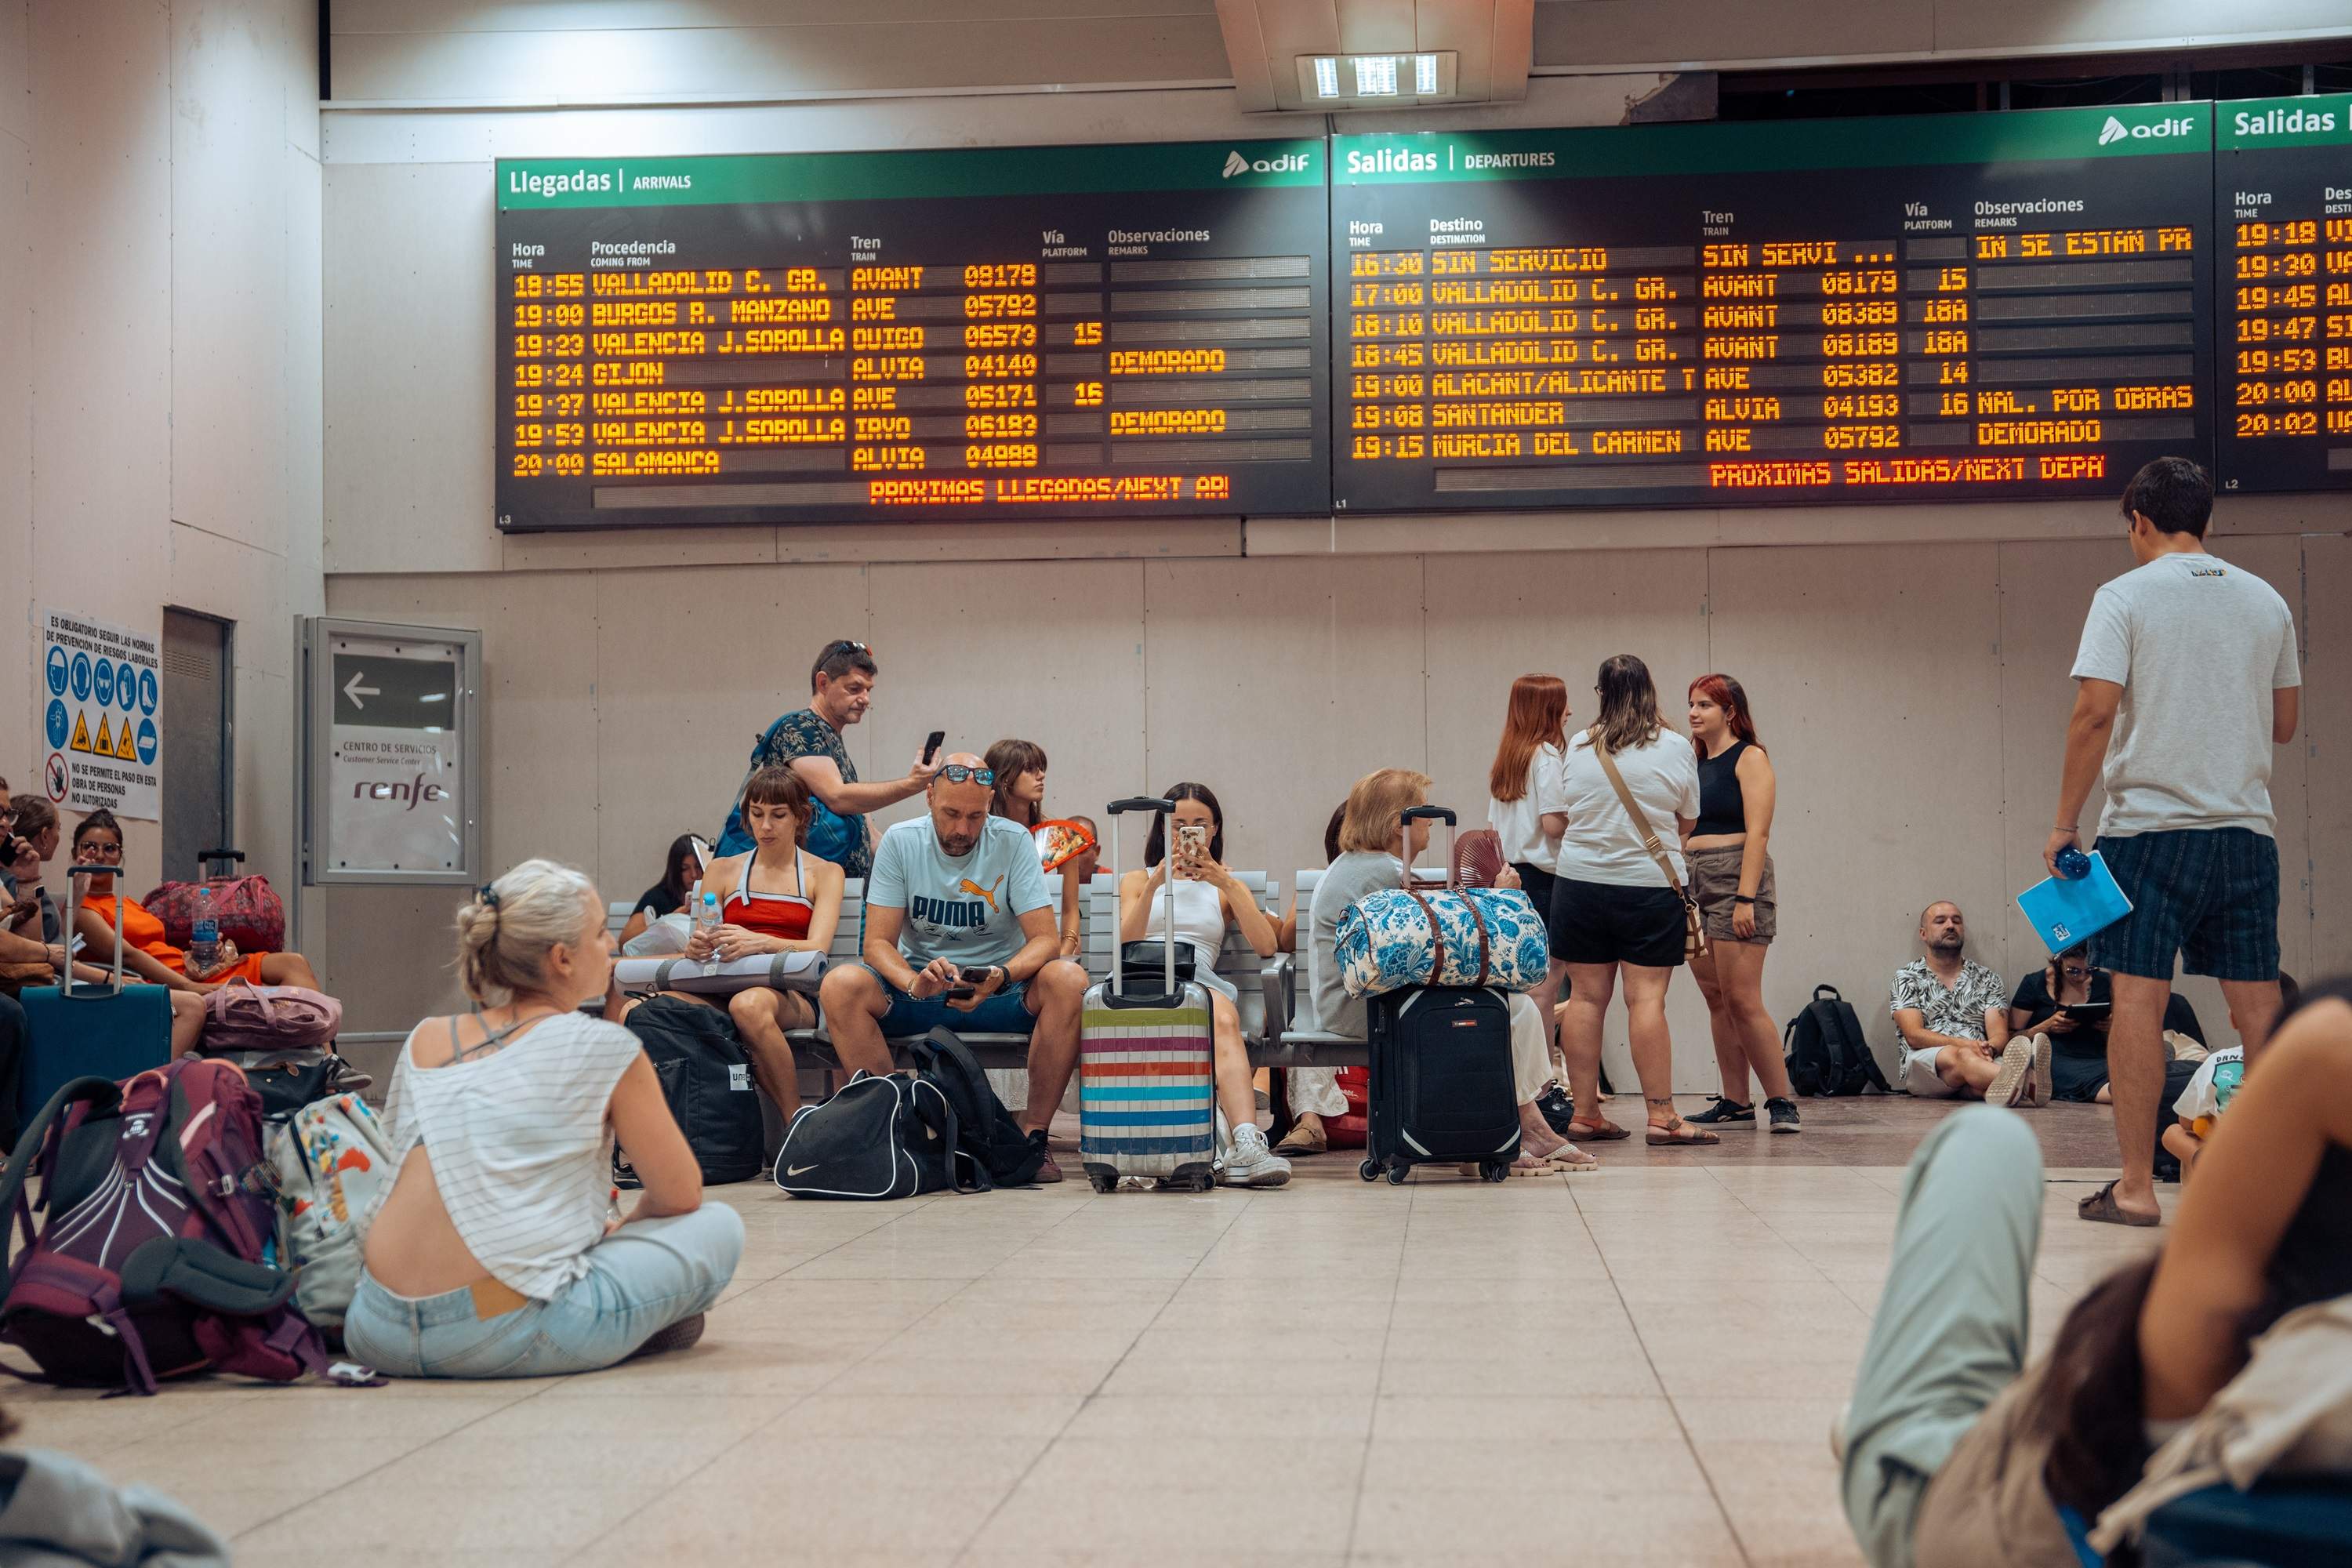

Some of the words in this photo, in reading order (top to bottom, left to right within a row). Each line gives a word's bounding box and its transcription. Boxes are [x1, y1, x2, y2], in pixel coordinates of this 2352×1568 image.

[2132, 118, 2194, 138] adif
[2234, 109, 2336, 136] Salidas
[1252, 154, 1309, 172] adif
[1348, 149, 1437, 173] Salidas
[1465, 153, 1555, 169] DEPARTURES
[510, 169, 611, 197] Llegadas
[633, 175, 691, 190] ARRIVALS
[1974, 199, 2084, 215] Observaciones
[2235, 191, 2272, 205] Hora
[1703, 211, 1734, 223] Tren
[1905, 203, 1928, 216] Vía
[2234, 209, 2258, 218] TIME
[1349, 221, 1383, 234] Hora
[1430, 219, 1483, 232] Destino
[1703, 227, 1729, 236] TRAIN
[1905, 220, 1952, 230] PLATFORM
[1974, 218, 2017, 227] REMARKS
[851, 237, 881, 249] Tren
[1043, 230, 1065, 244] Vía
[1108, 229, 1210, 243] Observaciones
[1349, 237, 1370, 247] TIME
[1430, 234, 1486, 245] DESTINATION
[2238, 221, 2316, 246] 19:18
[513, 242, 545, 256] Hora
[592, 240, 676, 255] Procedencia
[851, 252, 876, 261] TRAIN
[1042, 247, 1087, 257] PLATFORM
[1108, 246, 1149, 256] REMARKS
[1352, 253, 1424, 277] 16:30
[1432, 252, 1475, 274] SIN
[1490, 249, 1606, 273] SERVICIO
[1704, 245, 1748, 267] SIN
[1762, 242, 1836, 265] SERVI
[2021, 234, 2053, 256] SE
[2066, 230, 2144, 254] ESTAN
[512, 259, 532, 268] TIME
[590, 258, 624, 267] COMING
[626, 257, 650, 267] FROM
[2238, 253, 2315, 278] 19:30
[516, 274, 584, 297] 18:55
[593, 271, 732, 296] VALLADOLID
[745, 270, 771, 292] C.
[787, 269, 827, 292] GR.
[853, 267, 923, 290] AVANT
[965, 264, 1036, 287] 08178
[1352, 283, 1423, 307] 17:00
[1432, 280, 1577, 304] VALLADOLID
[1592, 279, 1617, 300] C.
[1635, 278, 1675, 299] GR.
[1704, 274, 1777, 296] AVANT
[1822, 270, 1896, 294] 08179
[1939, 268, 1966, 290] 15
[2238, 285, 2315, 310] 19:45
[515, 304, 584, 327] 19:00
[593, 303, 677, 326] BURGOS
[690, 302, 715, 324] R.
[731, 299, 831, 323] MANZANO
[853, 298, 895, 320] AVE
[965, 294, 1036, 318] 05792
[1352, 314, 1424, 337] 18:10
[1432, 310, 1578, 335] VALLADOLID
[1592, 310, 1618, 331] C.
[1635, 308, 1676, 330] GR.
[1704, 305, 1777, 328] AVANT
[1823, 302, 1896, 325] 08389
[1924, 299, 1967, 322] 18A
[2238, 317, 2315, 341] 19:47
[515, 334, 584, 357] 19:23
[593, 332, 705, 356] VALENCIA
[718, 328, 844, 353] J.SOROLLA
[965, 325, 1036, 347] 06573
[1075, 323, 1102, 345] 15
[1352, 344, 1423, 367] 18:45
[1432, 340, 1578, 365] VALLADOLID
[1592, 340, 1618, 361] C.
[1636, 339, 1676, 361] GR.
[1704, 336, 1778, 358] AVANT
[1824, 332, 1897, 356] 08189
[1925, 331, 1967, 353] 18A
[515, 364, 584, 387] 19:24
[593, 362, 664, 386] GIJON
[853, 358, 924, 380] ALVIA
[966, 354, 1037, 377] 04140
[1111, 350, 1226, 374] DEMORADO
[1352, 375, 1424, 397] 19:00
[1432, 369, 1665, 396] ALACANT/ALICANTE
[1705, 368, 1749, 389] AVE
[1824, 364, 1897, 387] 05382
[1940, 362, 1968, 383] 14
[516, 394, 585, 416] 19:37
[593, 391, 706, 416] VALENCIA
[853, 387, 896, 410] AVE
[1075, 383, 1103, 405] 16
[2237, 380, 2316, 405] 20:00
[1352, 405, 1423, 428] 19:08
[1432, 402, 1564, 426] SANTANDER
[1706, 397, 1779, 420] ALVIA
[1824, 394, 1898, 418] 04193
[1940, 393, 1968, 415] 16
[2053, 389, 2100, 411] POR
[2114, 386, 2192, 409] OBRAS
[1111, 410, 1226, 434] DEMORADO
[2238, 412, 2316, 436] 20:02
[1352, 436, 1424, 459] 19:15
[1433, 434, 1520, 457] MURCIA
[1534, 433, 1579, 455] DEL
[1593, 430, 1681, 454] CARMEN
[1706, 430, 1751, 451] AVE
[1825, 426, 1899, 448] 05792
[1979, 420, 2100, 445] DEMORADO
[593, 451, 720, 475] SALAMANCA
[1709, 463, 1832, 487] PROXIMAS
[1844, 458, 2024, 484] SALIDAS/NEXT
[868, 478, 986, 504] PROXIMAS
[995, 477, 1183, 502] LLEGADAS/NEXT
[2226, 479, 2238, 489] L2
[1336, 499, 1346, 508] L1
[499, 514, 511, 524] L3
[51, 615, 59, 628] ES
[60, 619, 98, 638] OBLIGATORIO
[99, 630, 120, 644] SEGUIR
[121, 635, 131, 648] LAS
[132, 638, 154, 654] NORMAS
[46, 630, 55, 641] DE
[94, 643, 102, 654] DE
[103, 645, 126, 660] RIESGOS
[128, 652, 158, 669] LABORALES
[343, 741, 378, 752] CENTRO
[381, 743, 391, 753] DE
[394, 743, 437, 754] SERVICIOS
[343, 754, 375, 764] Customer
[377, 756, 399, 765] Service
[72, 763, 80, 773] NO
[82, 764, 89, 775] SE
[89, 766, 113, 779] PERMITE
[114, 770, 121, 781] EL
[122, 771, 136, 783] PASO
[136, 774, 143, 785] EN
[144, 775, 157, 787] ESTA
[72, 778, 88, 790] OBRA
[89, 780, 96, 791] DE
[97, 782, 125, 796] PERSONAS
[354, 772, 441, 811] renfe
[72, 793, 81, 804] NO
[82, 794, 118, 809] AUTORIZADAS
[913, 895, 985, 927] PUMA
